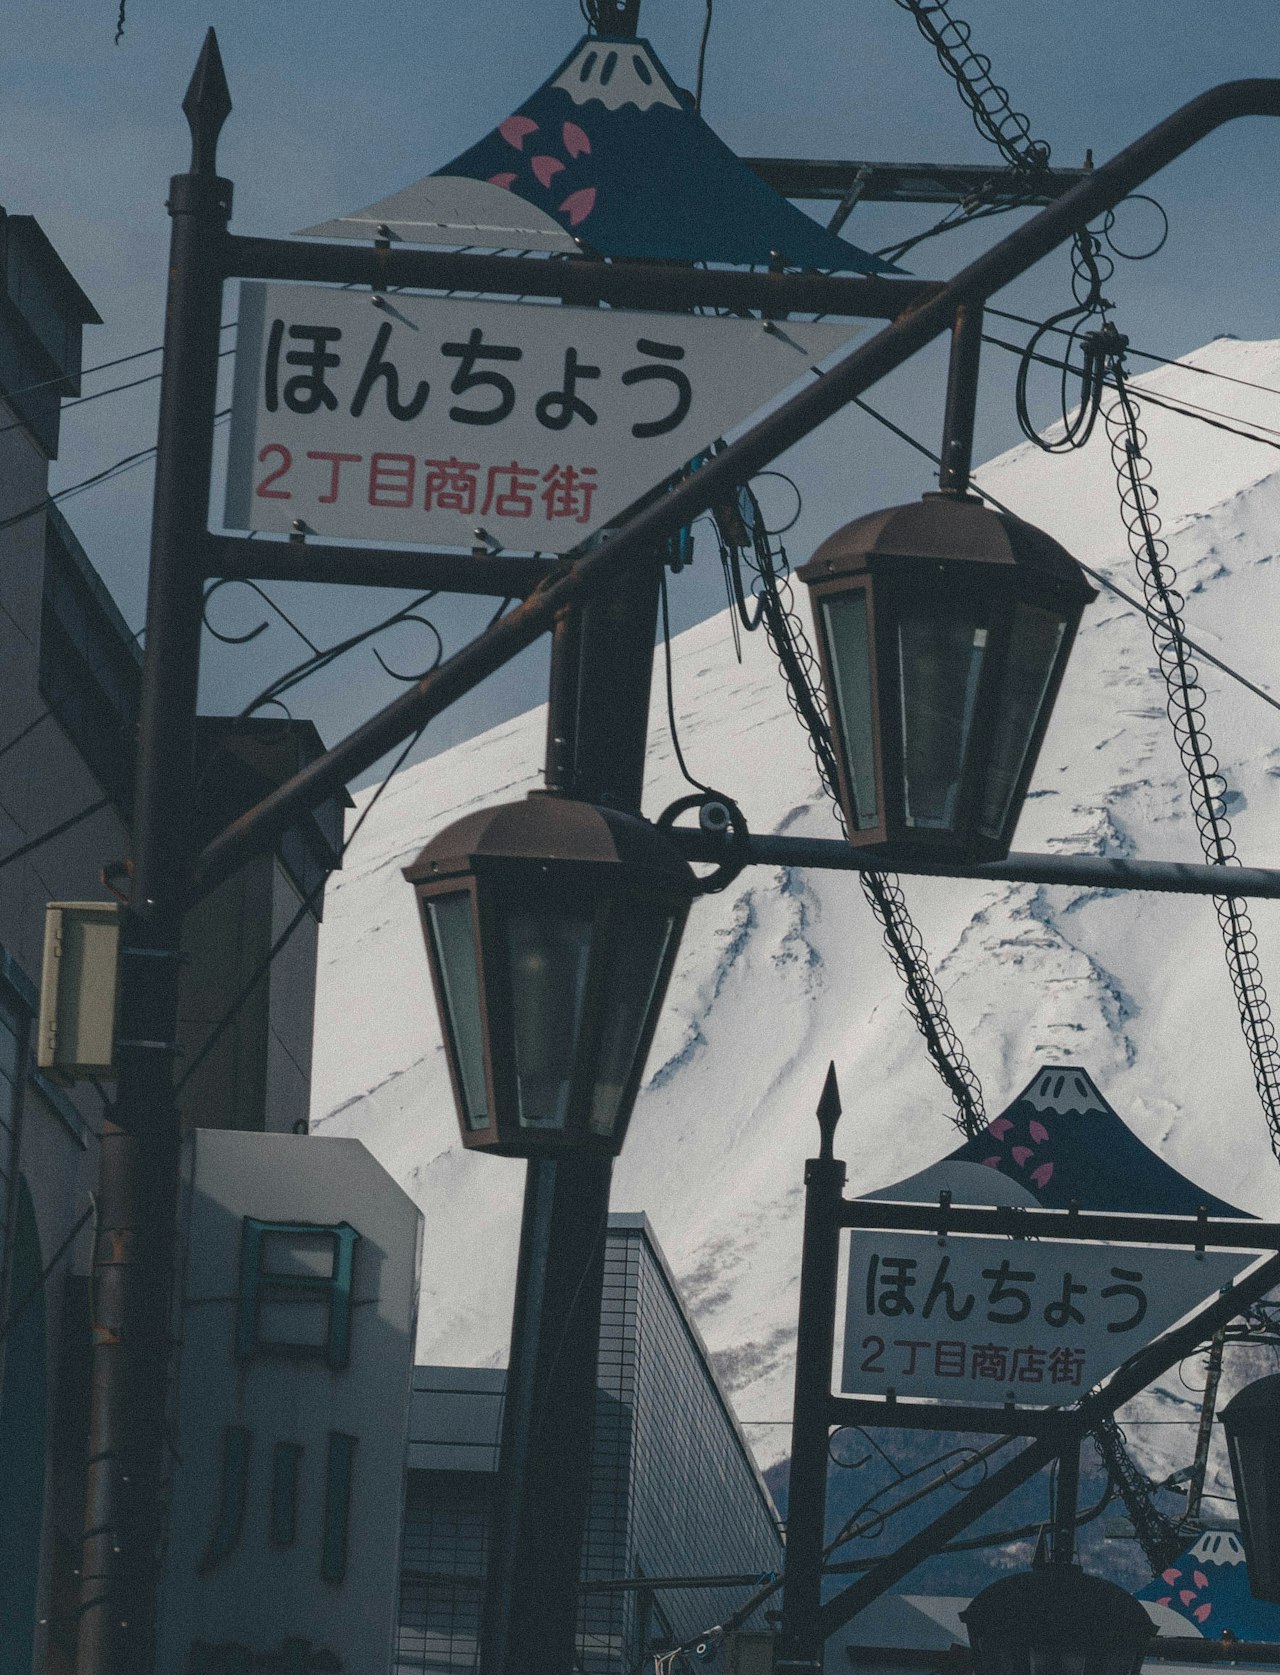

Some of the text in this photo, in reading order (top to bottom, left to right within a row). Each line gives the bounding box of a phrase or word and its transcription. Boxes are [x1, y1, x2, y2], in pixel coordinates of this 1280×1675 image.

[264, 315, 695, 440] ほんちょう
[255, 443, 601, 526] 2丁目商店街
[864, 1253, 1148, 1334] ほんちょう
[860, 1334, 1087, 1387] 2丁目商店街
